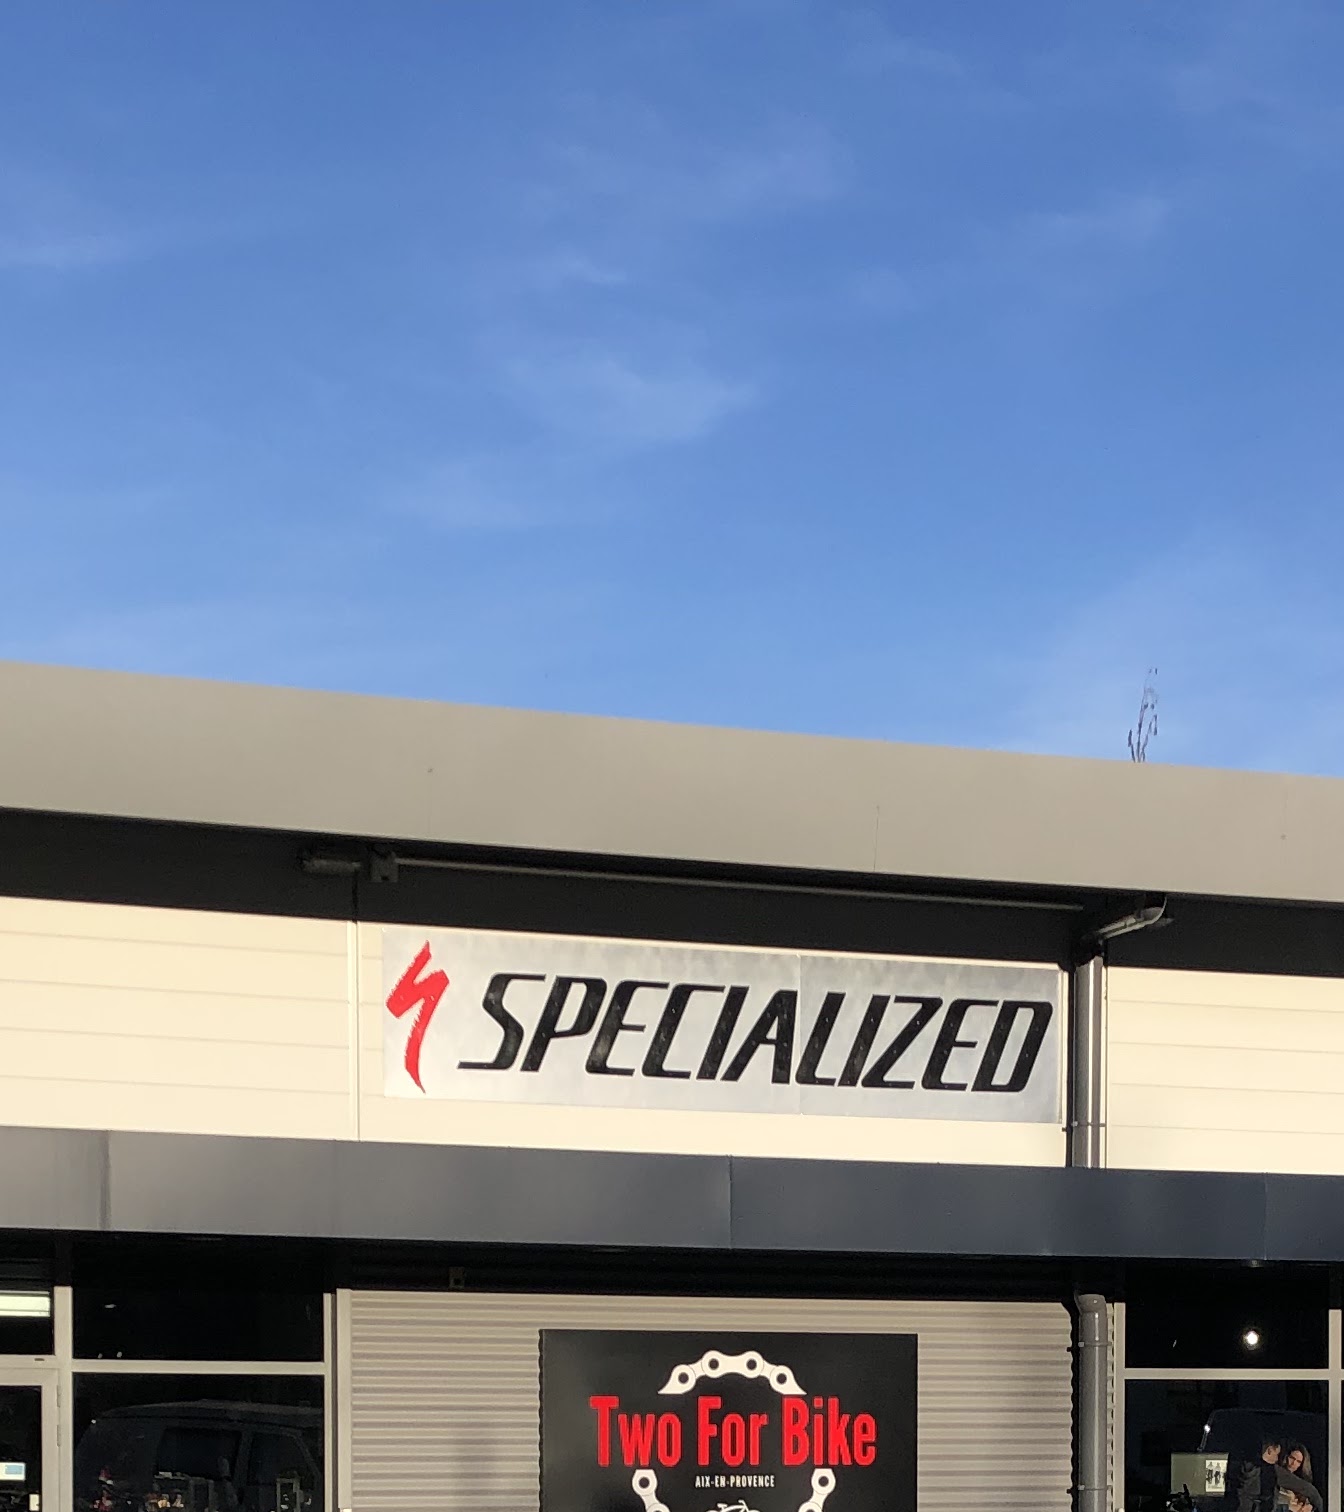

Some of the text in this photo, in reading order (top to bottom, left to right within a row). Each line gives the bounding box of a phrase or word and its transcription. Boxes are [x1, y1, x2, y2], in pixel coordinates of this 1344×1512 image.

[458, 973, 1053, 1093] SPECIALIZED
[590, 1395, 877, 1467] Two For Bike
[695, 1475, 775, 1488] AIX-EN-PROVENCE
